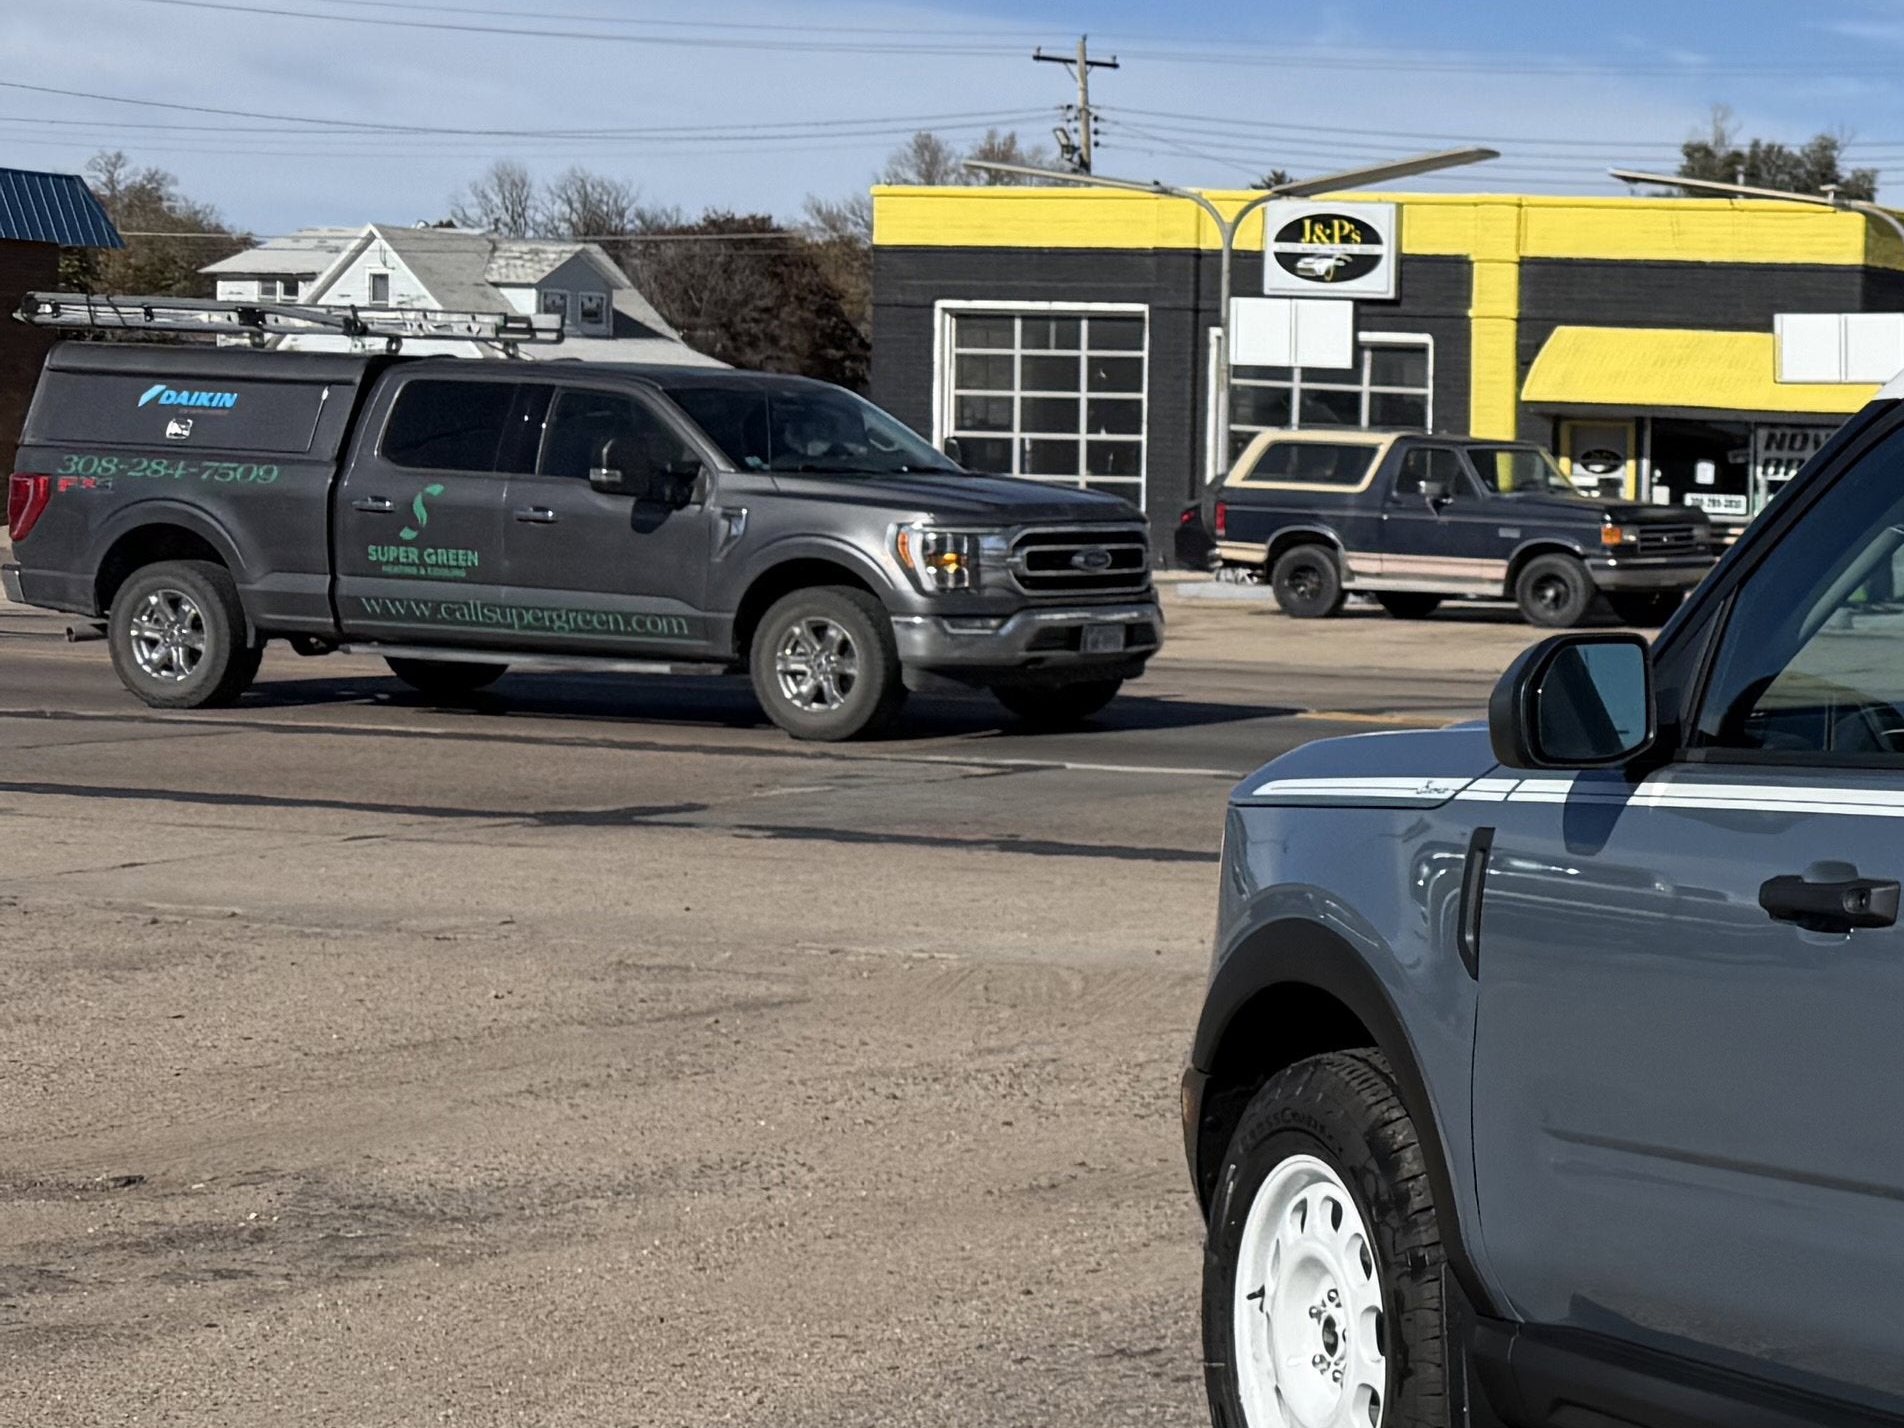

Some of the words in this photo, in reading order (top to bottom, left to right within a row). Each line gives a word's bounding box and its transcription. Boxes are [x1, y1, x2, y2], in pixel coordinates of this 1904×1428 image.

[1301, 219, 1361, 244] J&P's
[158, 390, 239, 409] DAIKIN
[57, 454, 279, 485] 308-284-7509
[367, 545, 419, 563] SUPER
[424, 548, 479, 567] GREEN
[361, 596, 689, 636] www.callsupergreen.com
